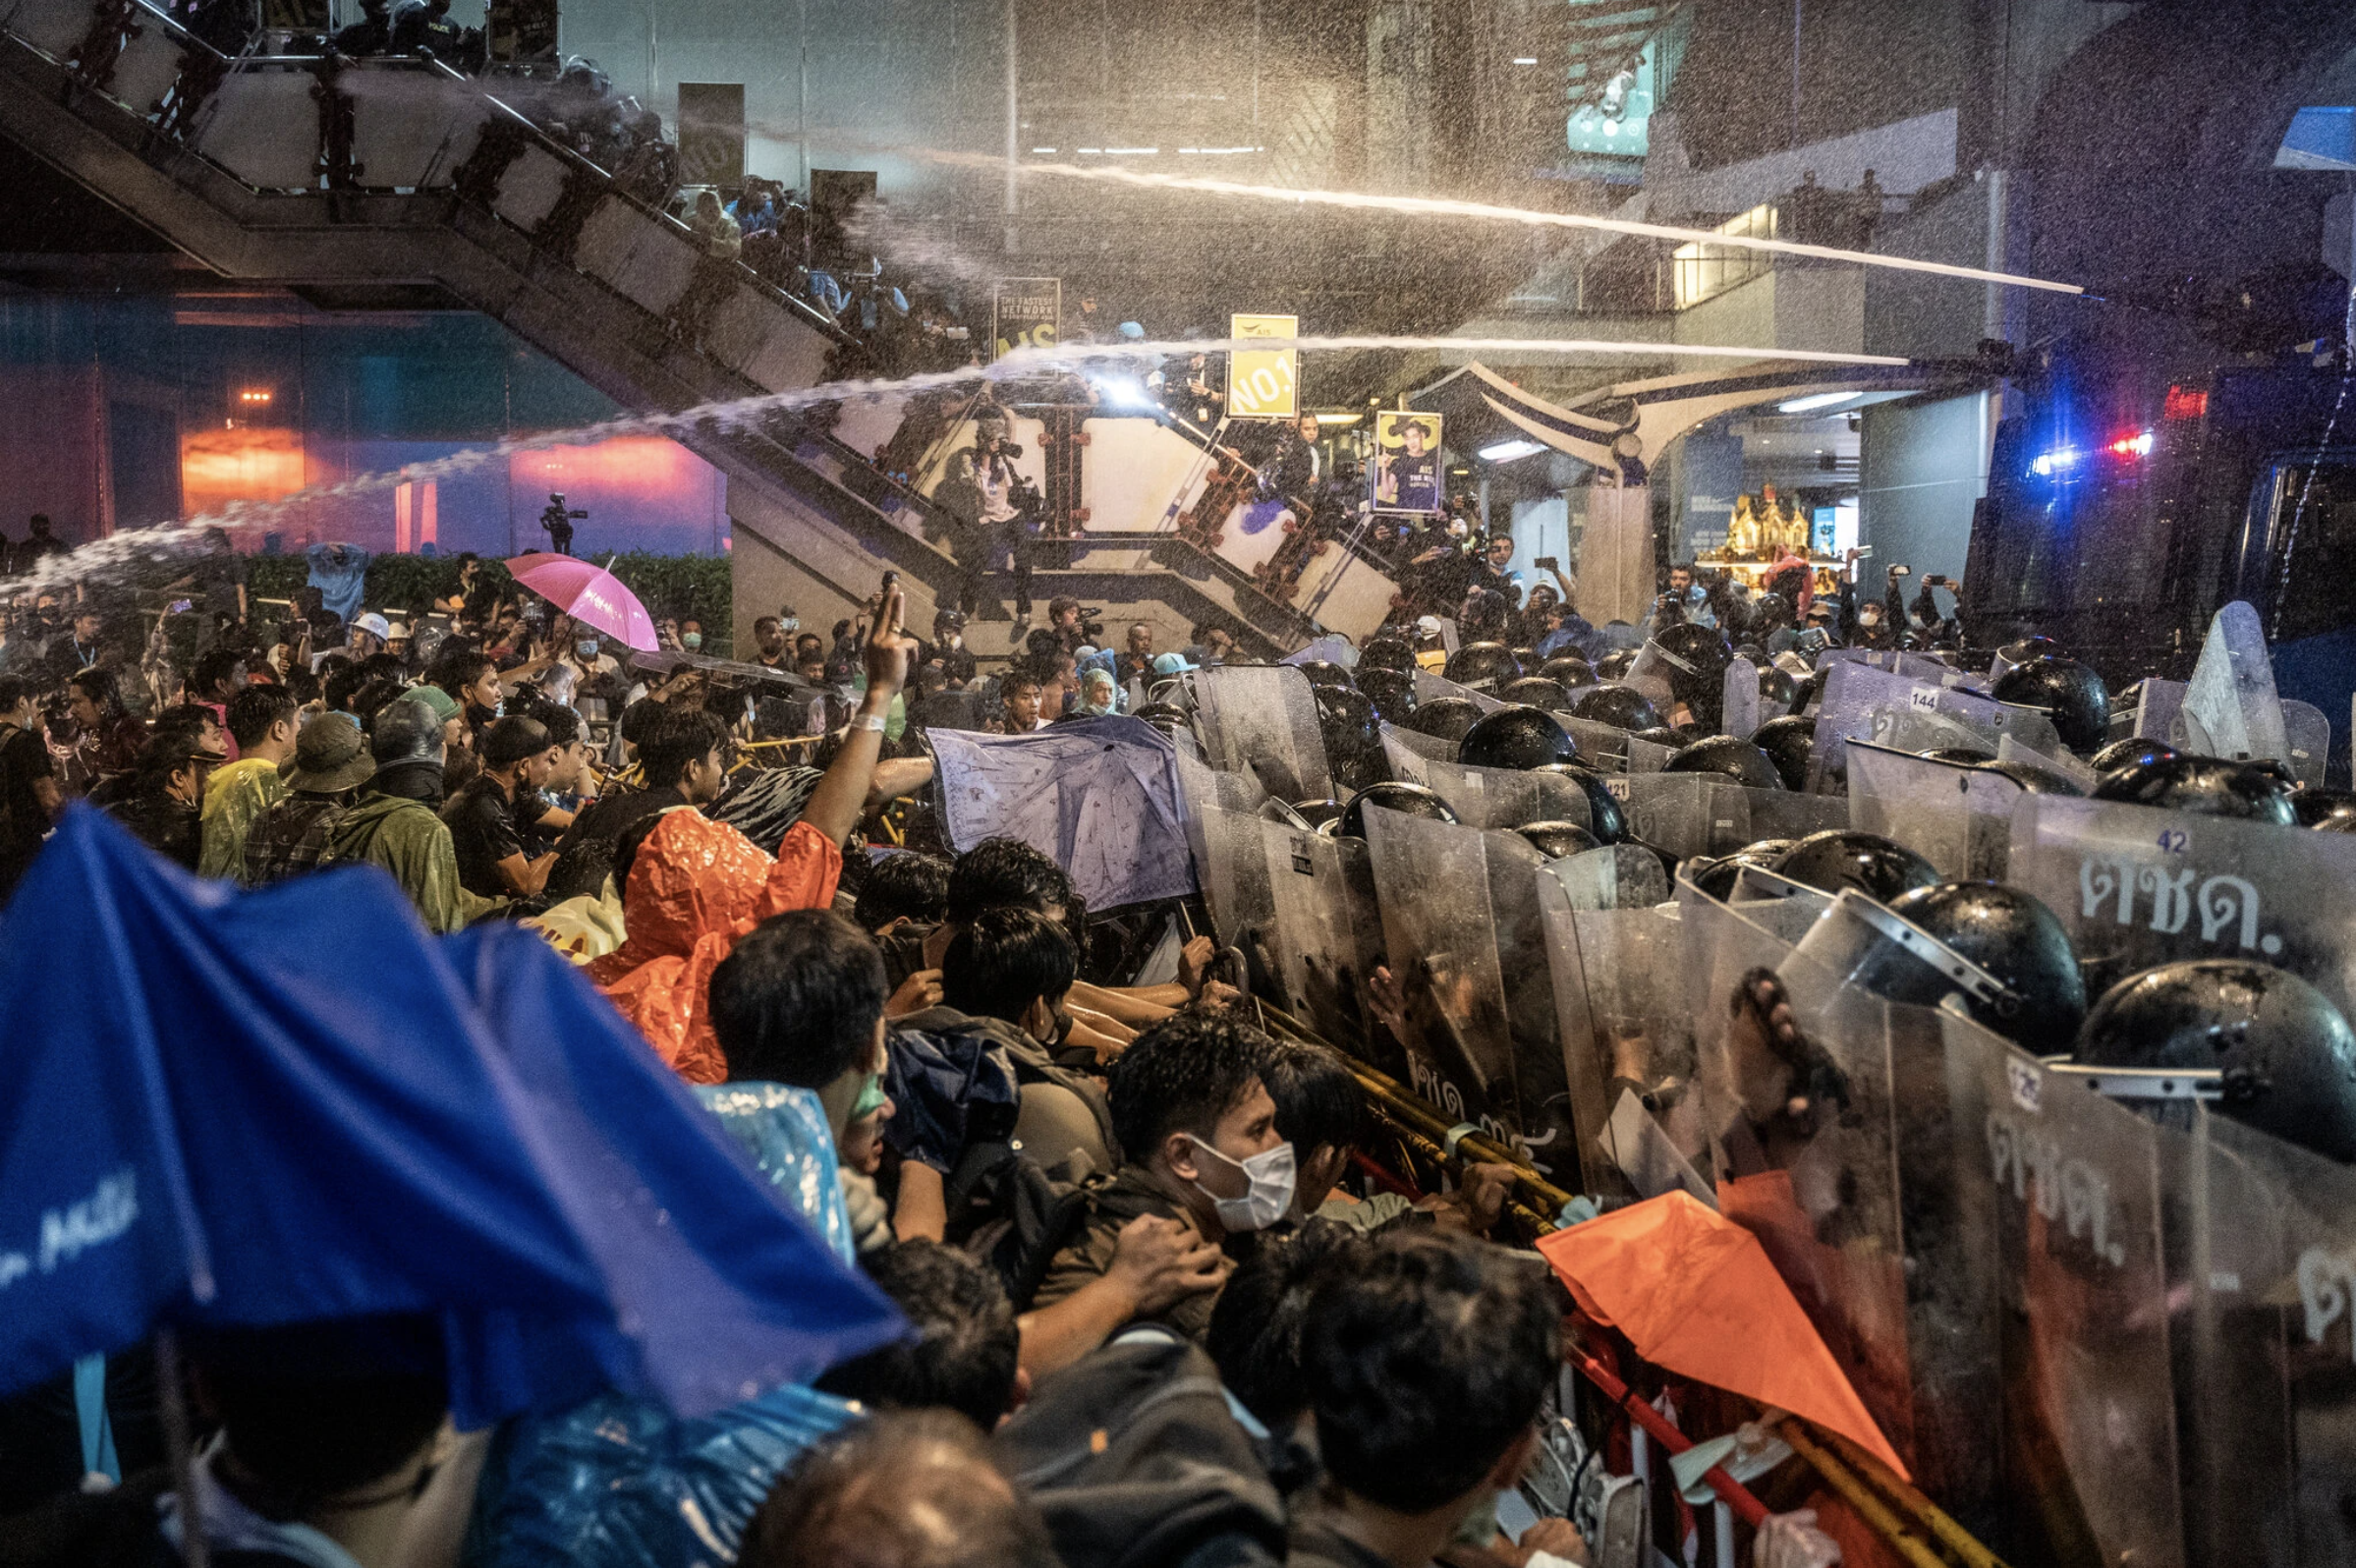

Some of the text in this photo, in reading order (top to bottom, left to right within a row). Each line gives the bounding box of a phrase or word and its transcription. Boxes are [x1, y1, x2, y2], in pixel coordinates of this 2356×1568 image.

[428, 21, 450, 33] POLICE
[1000, 297, 1053, 306] THE FASTEST
[1000, 305, 1053, 314] NETWORK
[1231, 356, 1294, 413] NO.1
[1912, 693, 1936, 709] 144
[1608, 783, 1627, 797] 121
[2157, 829, 2187, 853] 42
